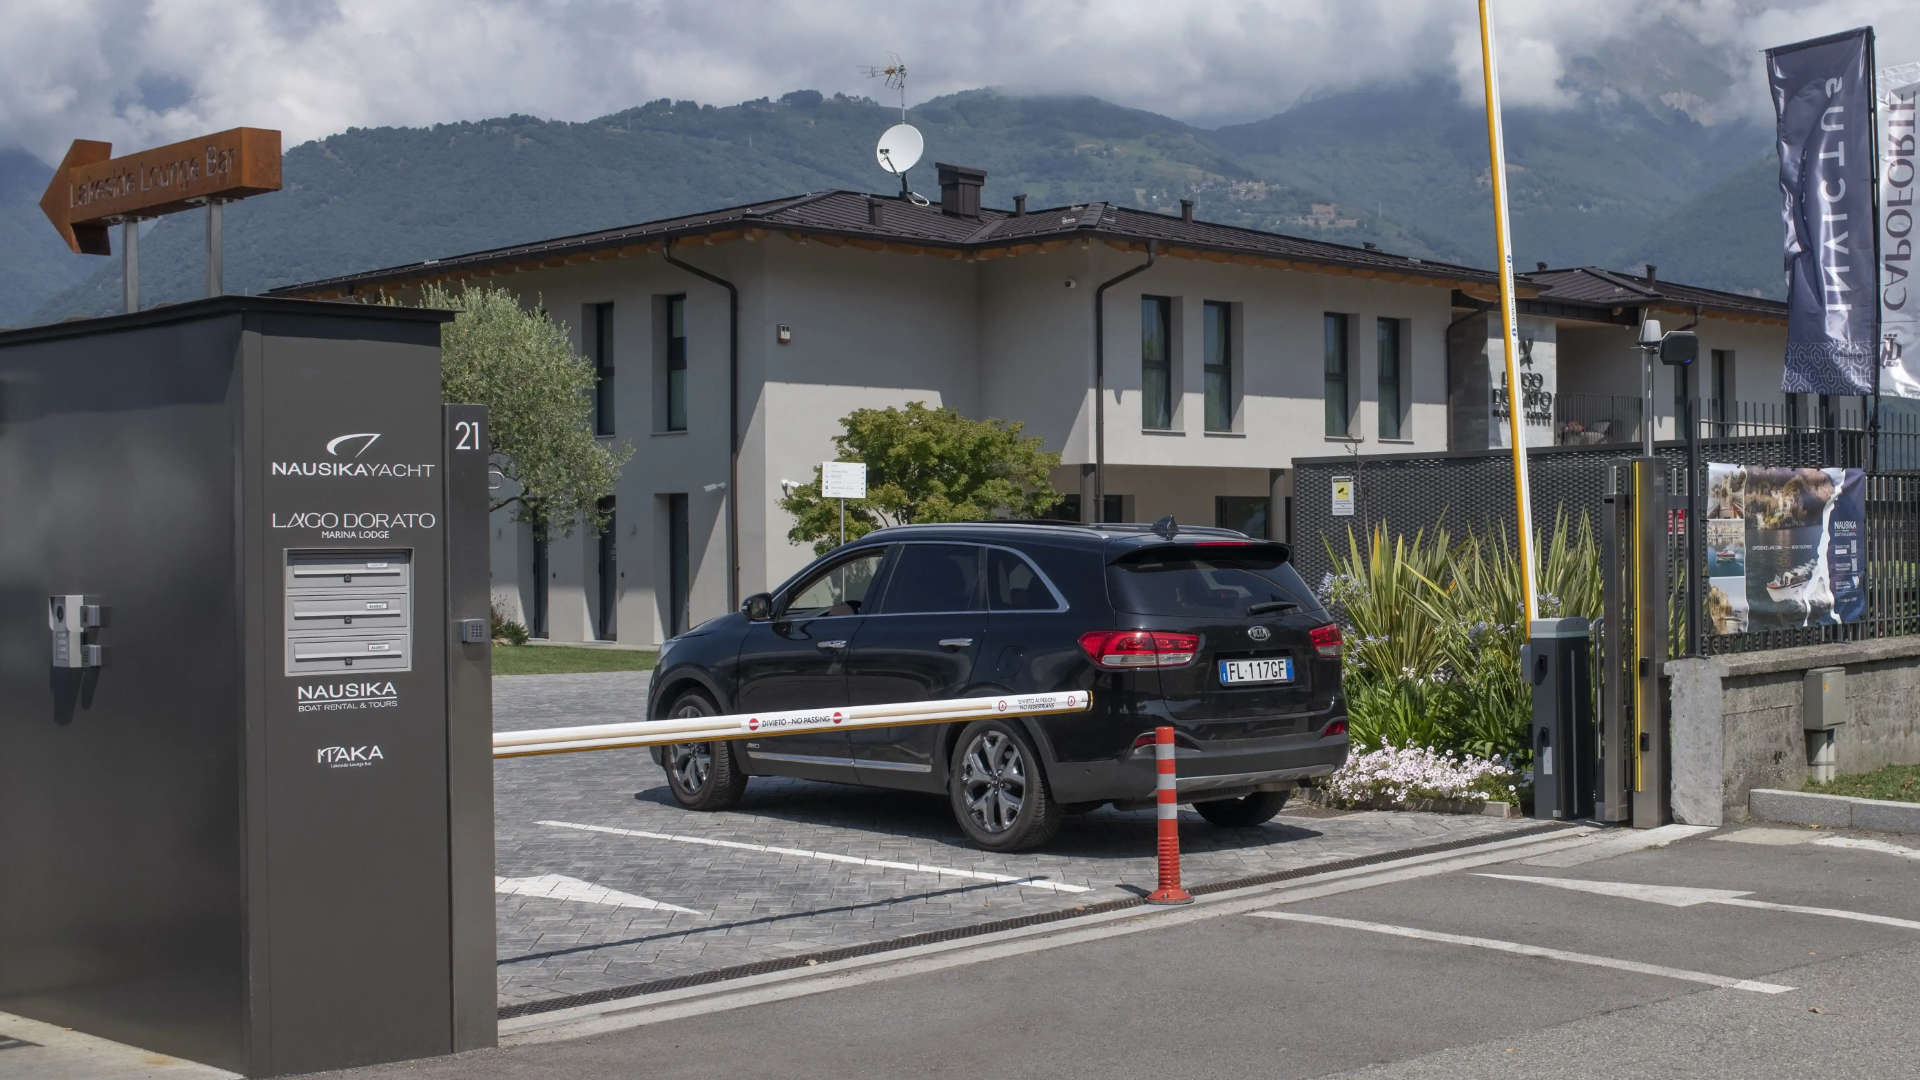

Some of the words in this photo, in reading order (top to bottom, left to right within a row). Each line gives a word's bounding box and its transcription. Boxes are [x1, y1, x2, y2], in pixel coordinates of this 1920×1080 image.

[69, 168, 136, 209] Lakeside
[140, 156, 200, 192] Lounge
[205, 146, 235, 177] Bar
[455, 421, 480, 450] 21
[272, 462, 436, 477] NAUSIKAYACHT
[272, 512, 339, 529] LAGO
[343, 512, 436, 529] DORATO
[321, 530, 357, 539] MARINA
[359, 530, 390, 539] LODGE
[297, 681, 398, 700] NAUSIKA
[298, 704, 322, 713] BOAT
[323, 702, 358, 711] RENTAL
[368, 700, 398, 709] TOURS
[762, 718, 787, 728] DIVIETO
[792, 717, 802, 725] NO
[804, 716, 831, 724] PASSING
